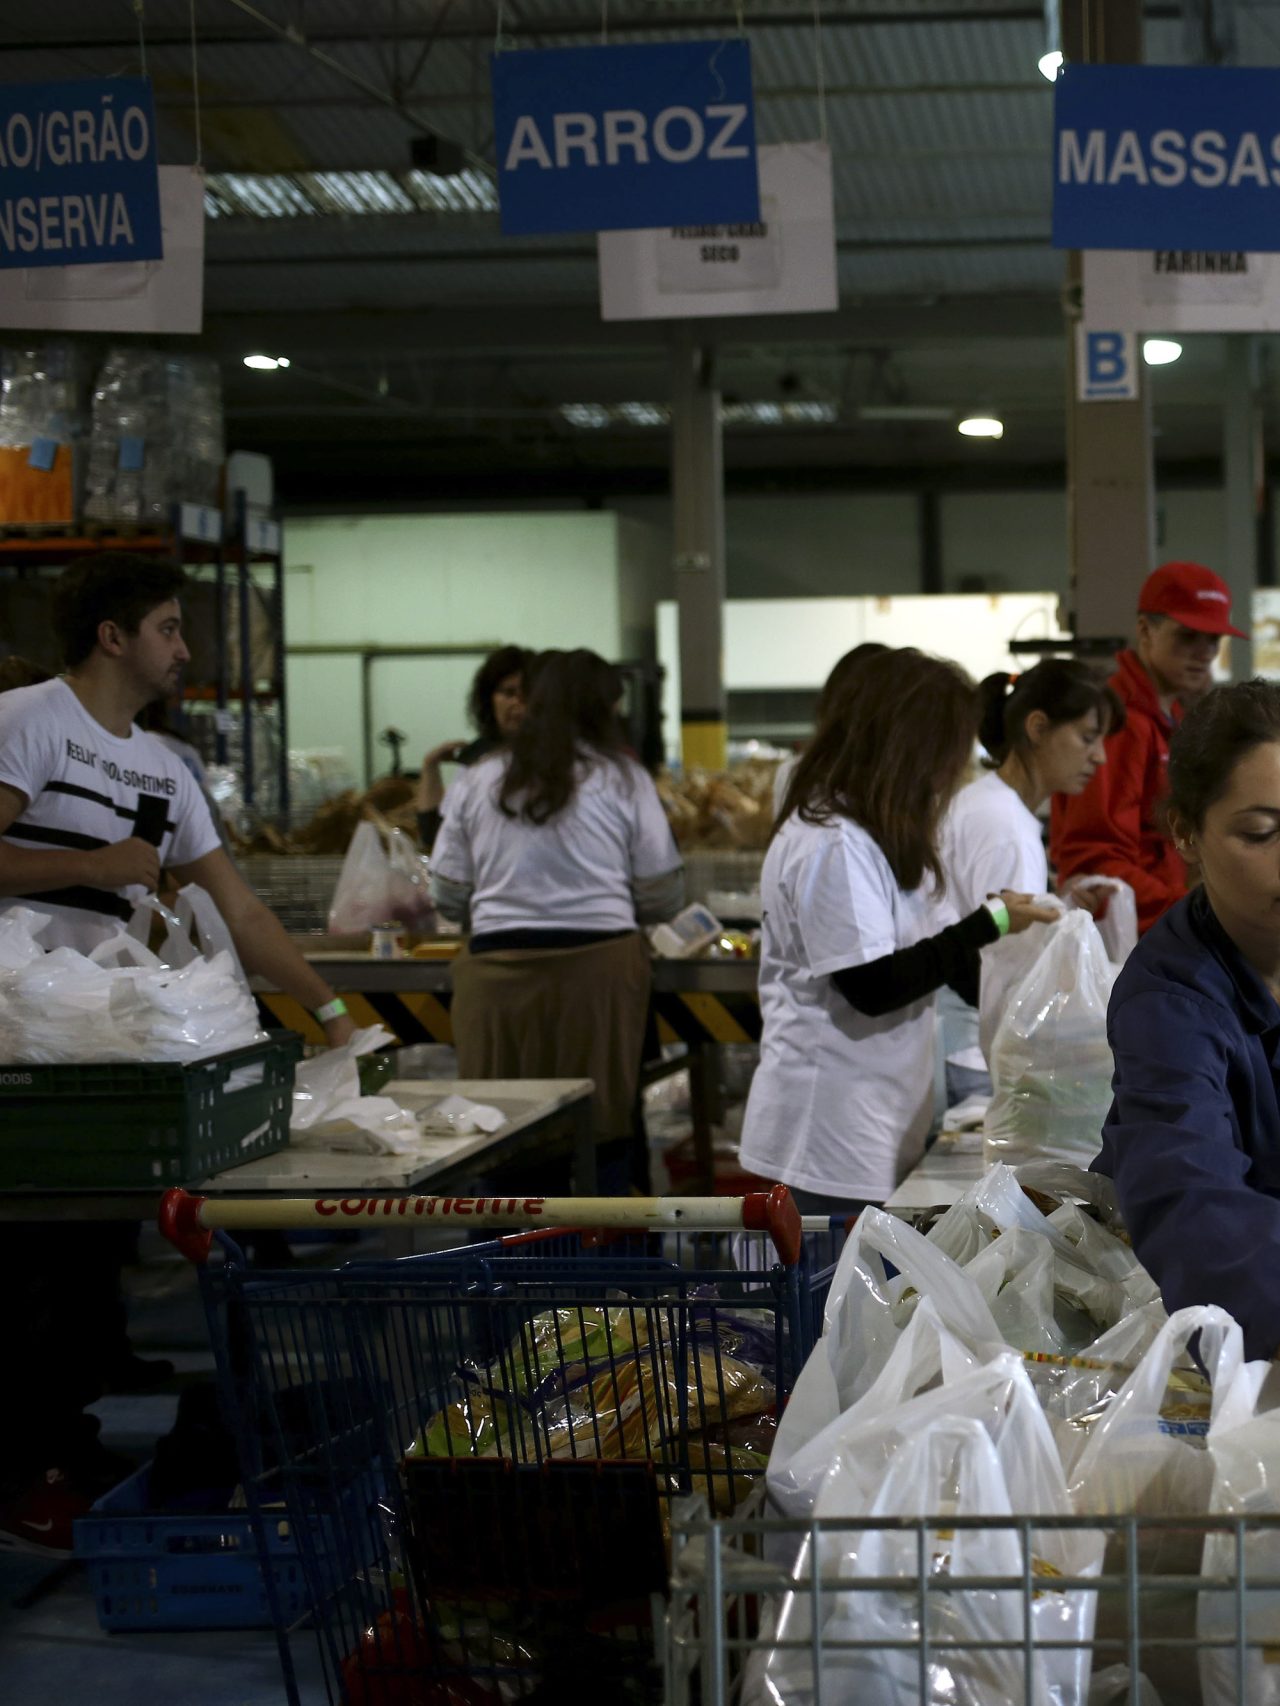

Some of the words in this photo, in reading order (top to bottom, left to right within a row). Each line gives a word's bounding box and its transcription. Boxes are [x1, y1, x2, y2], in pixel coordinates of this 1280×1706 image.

[503, 103, 750, 171] ARROZ
[1153, 251, 1248, 274] FARINHA
[1086, 331, 1127, 384] B
[0, 1072, 33, 1086] ODIS
